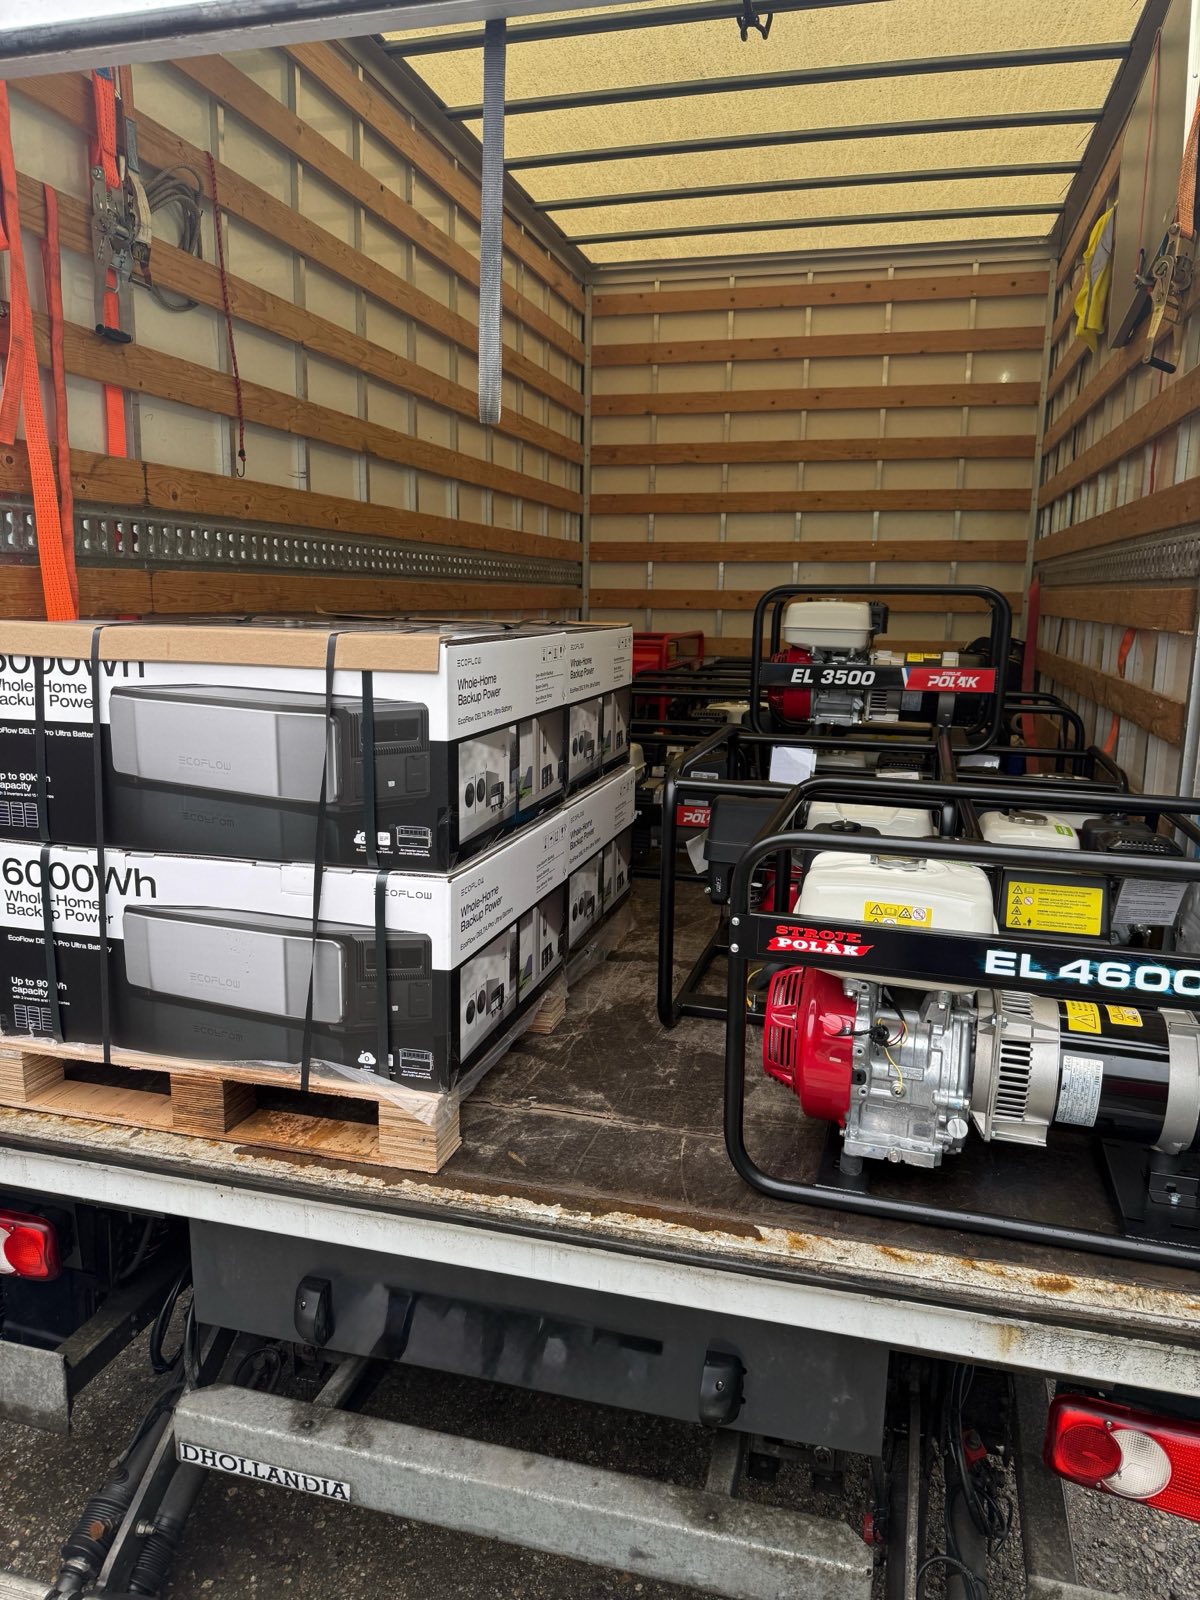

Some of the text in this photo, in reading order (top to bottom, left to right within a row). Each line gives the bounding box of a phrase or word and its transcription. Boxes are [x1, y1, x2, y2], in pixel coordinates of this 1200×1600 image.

[457, 674, 497, 691] Whole-Home
[790, 668, 876, 686] EL 3500
[0, 678, 87, 695] holeHome
[0, 693, 94, 709] acku Powe
[458, 687, 502, 706] Backup Power
[178, 755, 232, 771] ECOFLOW
[0, 772, 6, 782] p
[8, 772, 18, 780] to
[0, 782, 32, 792] apacity
[683, 812, 710, 824] POL
[2, 857, 156, 898] 6000Wh
[460, 886, 500, 918] Whole-Home
[6, 902, 60, 922] Backp
[460, 896, 503, 932] Backup Power
[8, 934, 34, 944] EcoFlow
[71, 942, 87, 950] Ultra
[88, 943, 112, 952] Batty
[776, 924, 862, 944] STROJE
[776, 937, 859, 956] POLÁK
[11, 976, 24, 986] Up
[25, 978, 34, 986] to
[190, 972, 240, 988] ECOFLOW
[984, 949, 1200, 996] EL 4600
[12, 986, 48, 998] capacity
[182, 1444, 348, 1500] DHOLLANDIA
